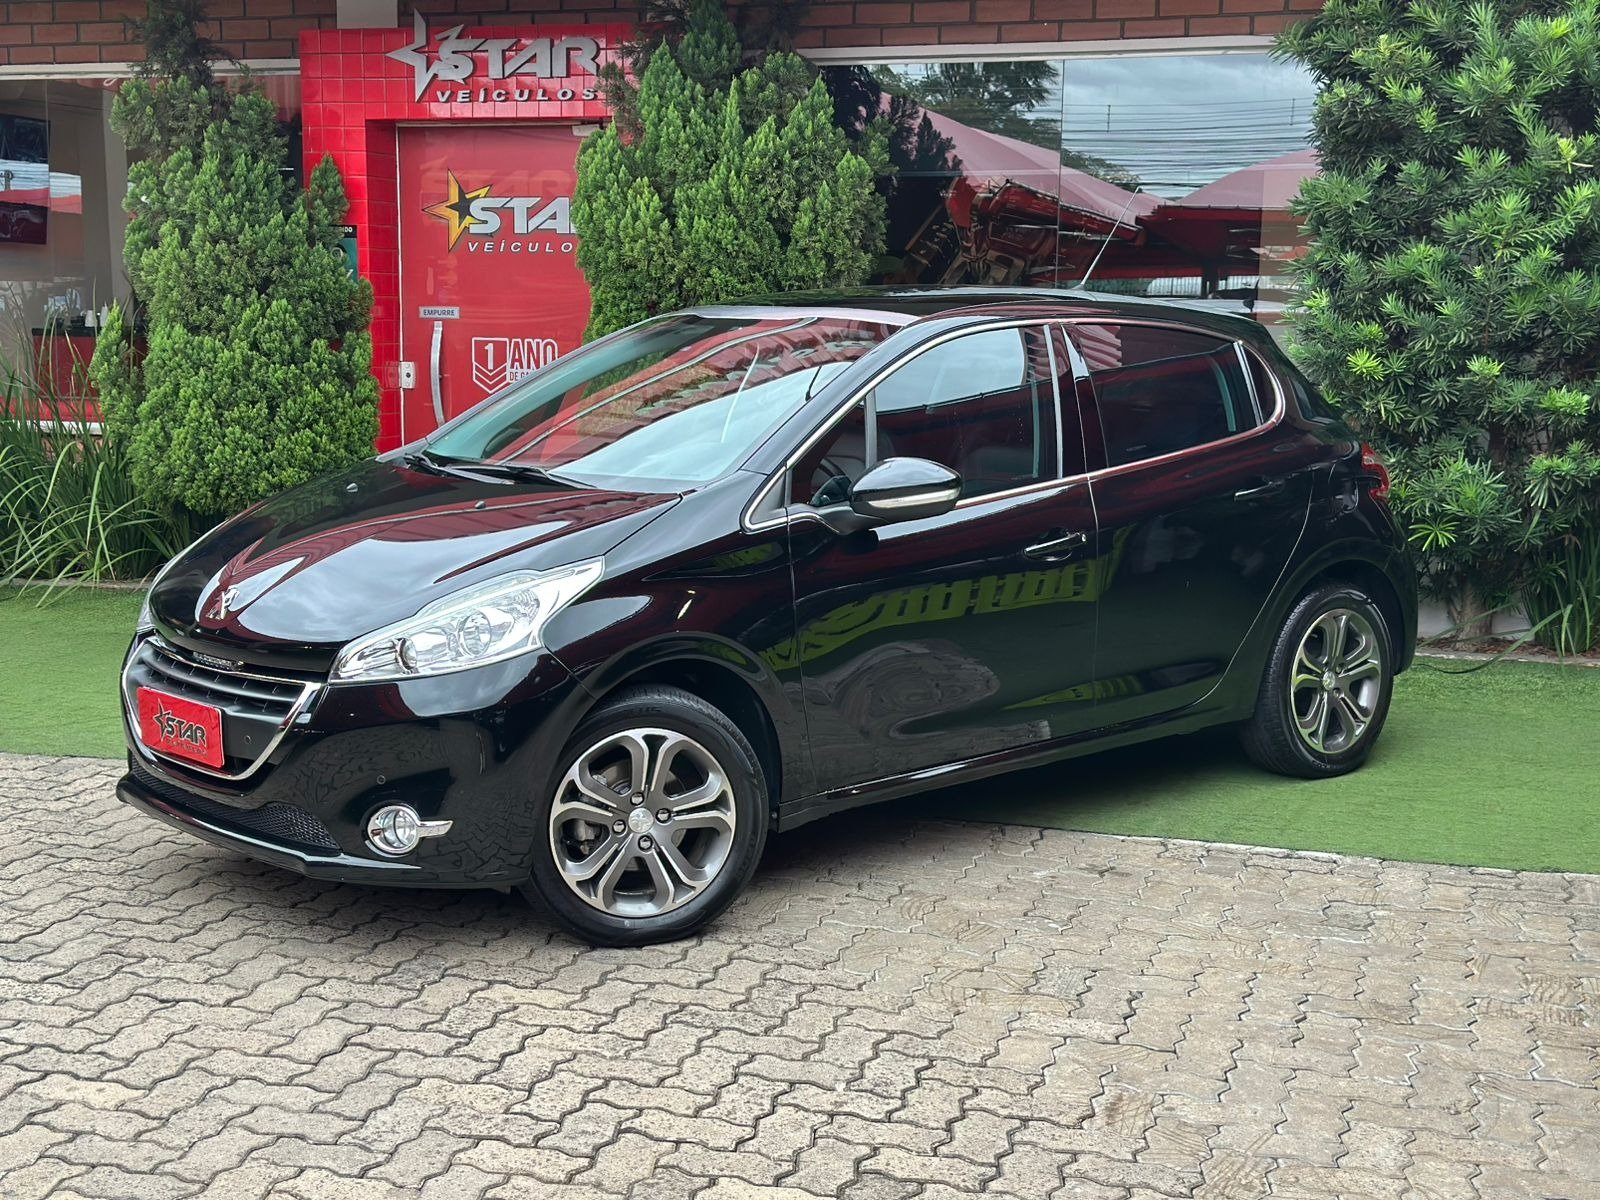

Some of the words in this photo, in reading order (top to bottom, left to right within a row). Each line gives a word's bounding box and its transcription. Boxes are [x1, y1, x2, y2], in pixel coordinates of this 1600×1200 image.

[438, 37, 598, 82] STAR
[436, 87, 598, 103] VEÍCULOS
[469, 196, 577, 235] STA
[468, 240, 574, 253] VEÍCULO
[484, 343, 494, 370] 1
[509, 339, 558, 370] ANO
[509, 371, 518, 381] DE
[165, 715, 207, 747] STAR
